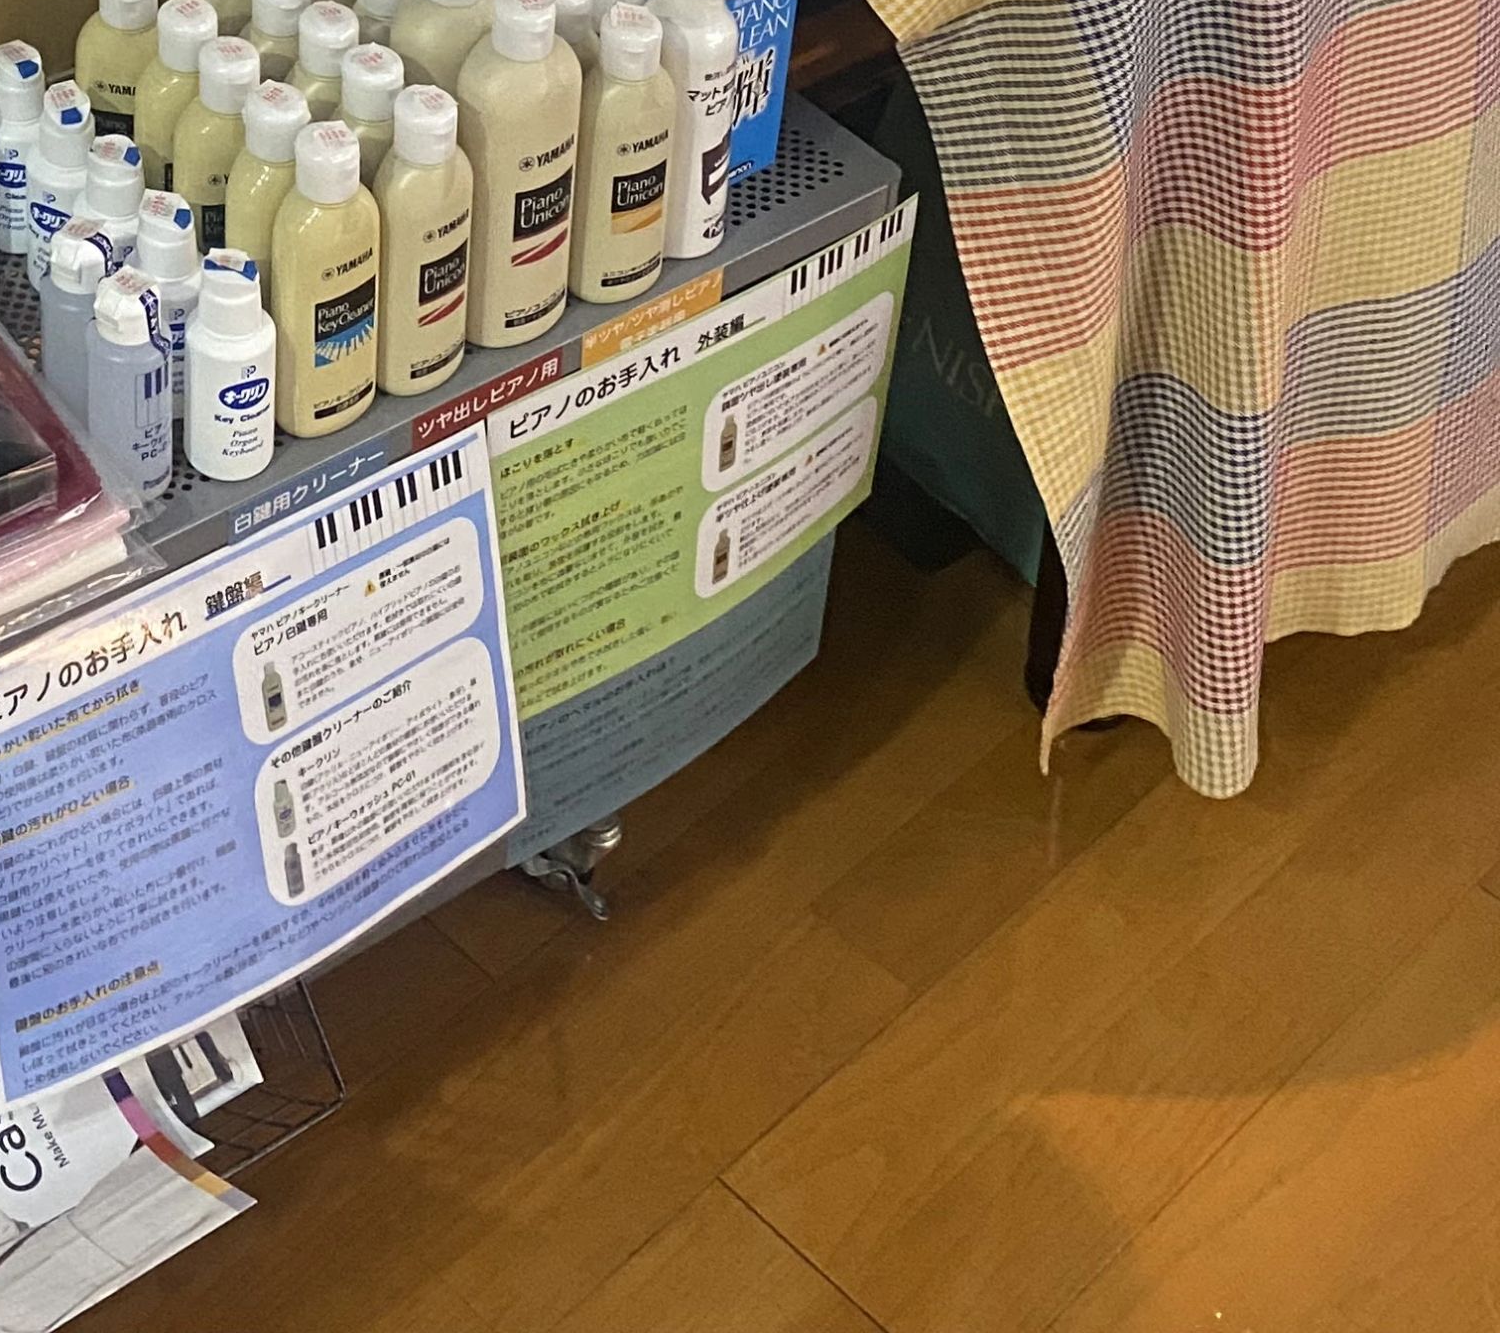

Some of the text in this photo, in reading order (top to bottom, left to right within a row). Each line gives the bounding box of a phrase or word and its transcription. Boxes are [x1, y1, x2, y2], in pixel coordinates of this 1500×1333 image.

[738, 13, 793, 53] LEAN
[535, 134, 575, 168] YAMAHA
[631, 129, 669, 154] YAMAHA
[520, 186, 564, 214] Piano
[616, 174, 657, 196] Piano
[616, 182, 664, 207] Unicon
[437, 208, 470, 239] YAMAHA
[520, 194, 570, 230] Unicon
[336, 247, 374, 277] YAMAHA
[423, 257, 460, 280] Piano
[423, 261, 467, 295] Unicon
[317, 301, 350, 322] Piano
[417, 357, 560, 437] ツヤ出しピアノ用
[509, 343, 681, 440] ピアノのお手入れ
[214, 414, 234, 425] Key
[232, 427, 259, 438] Piano
[221, 440, 264, 458] Keyboard
[230, 435, 260, 448] Organ
[233, 447, 385, 534] 白鍵用クリーナー
[253, 608, 329, 656] ピアノ白鍵専用
[298, 747, 341, 778] キークリン
